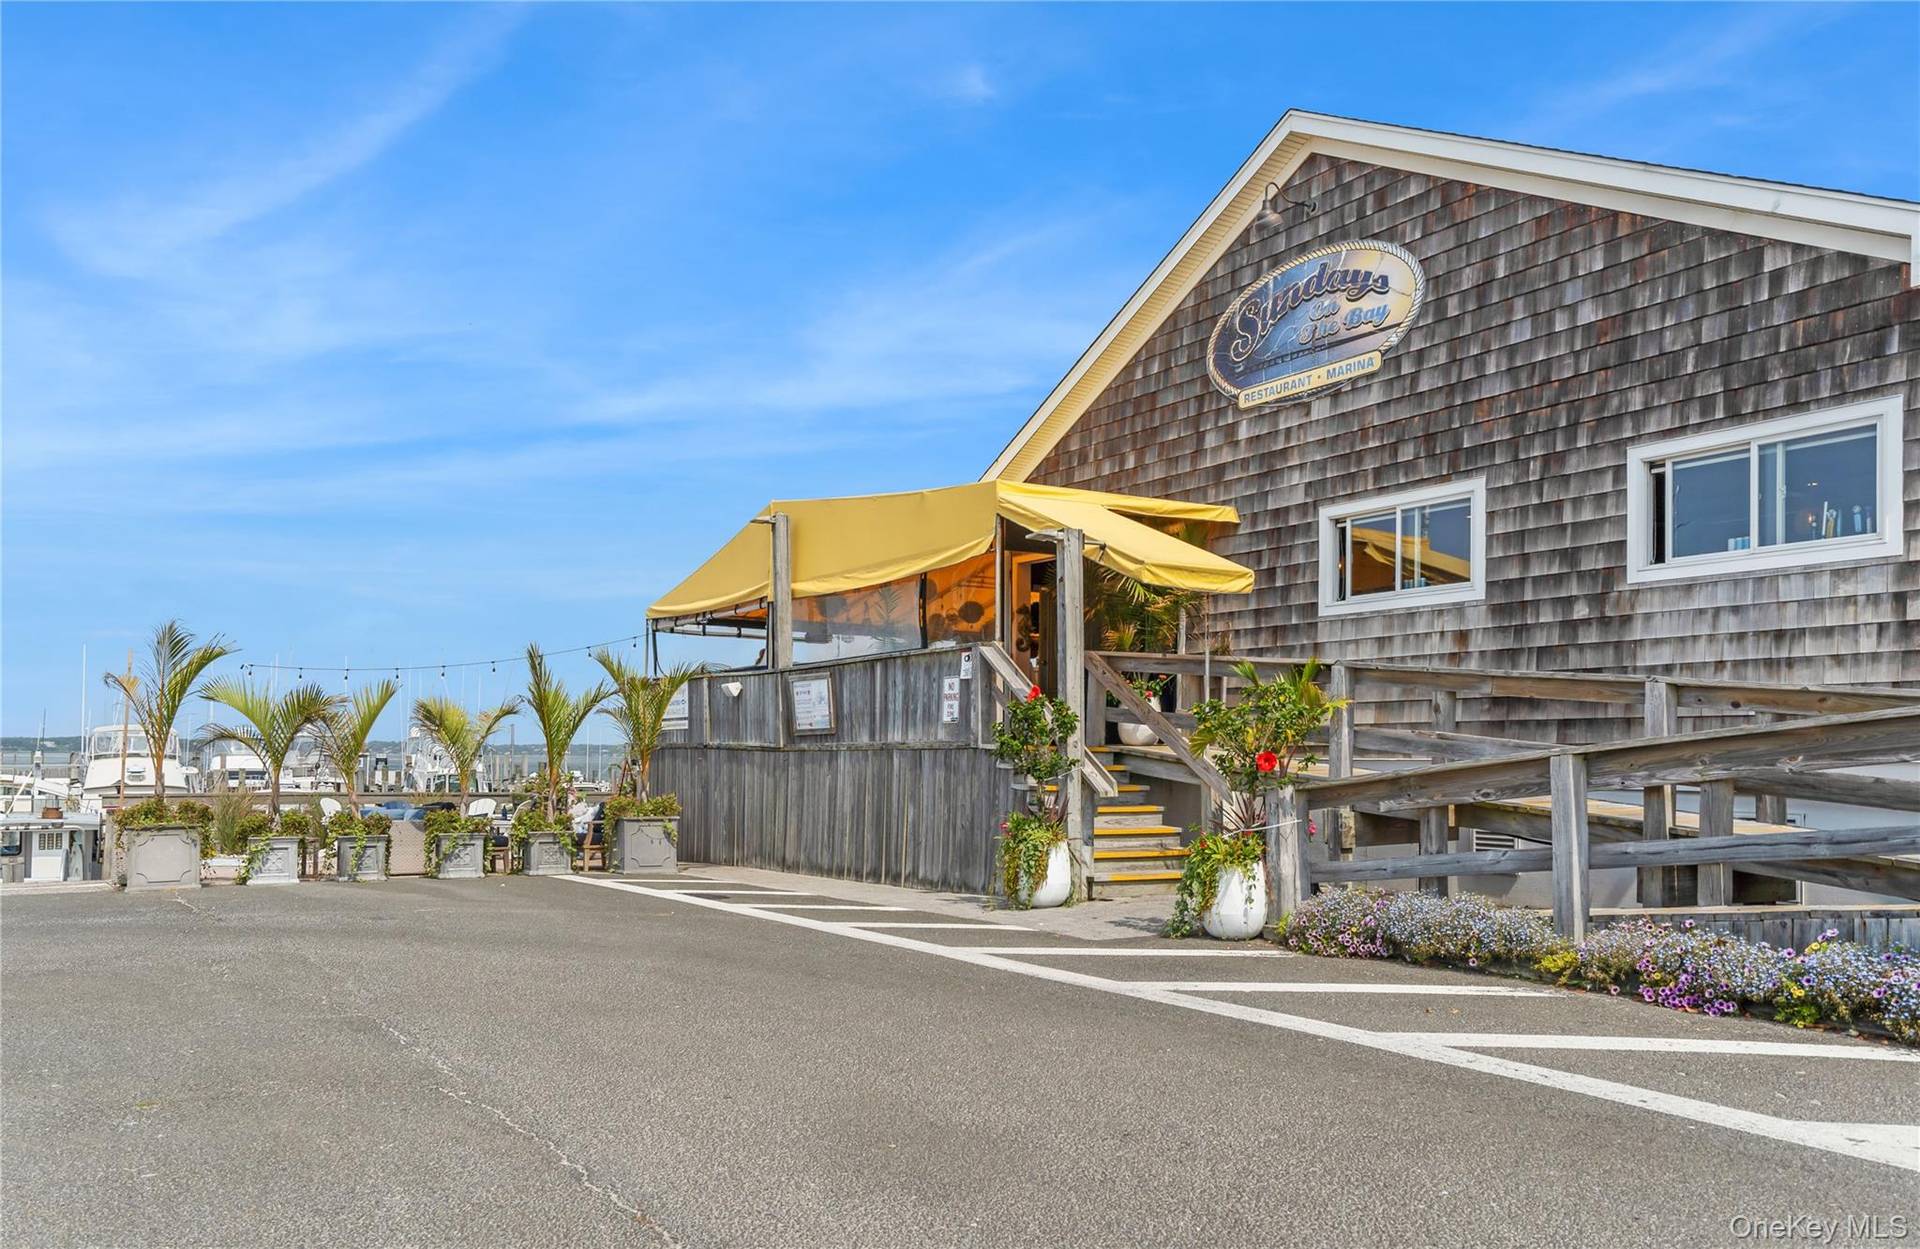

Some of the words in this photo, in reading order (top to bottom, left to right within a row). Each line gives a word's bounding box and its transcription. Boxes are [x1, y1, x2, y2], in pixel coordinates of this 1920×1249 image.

[1231, 260, 1389, 361] Sundays
[1299, 319, 1340, 344] The
[1344, 303, 1391, 327] Bay
[1309, 299, 1341, 321] On
[1243, 375, 1313, 404] RESTAURANT
[1326, 356, 1376, 381] MARINA
